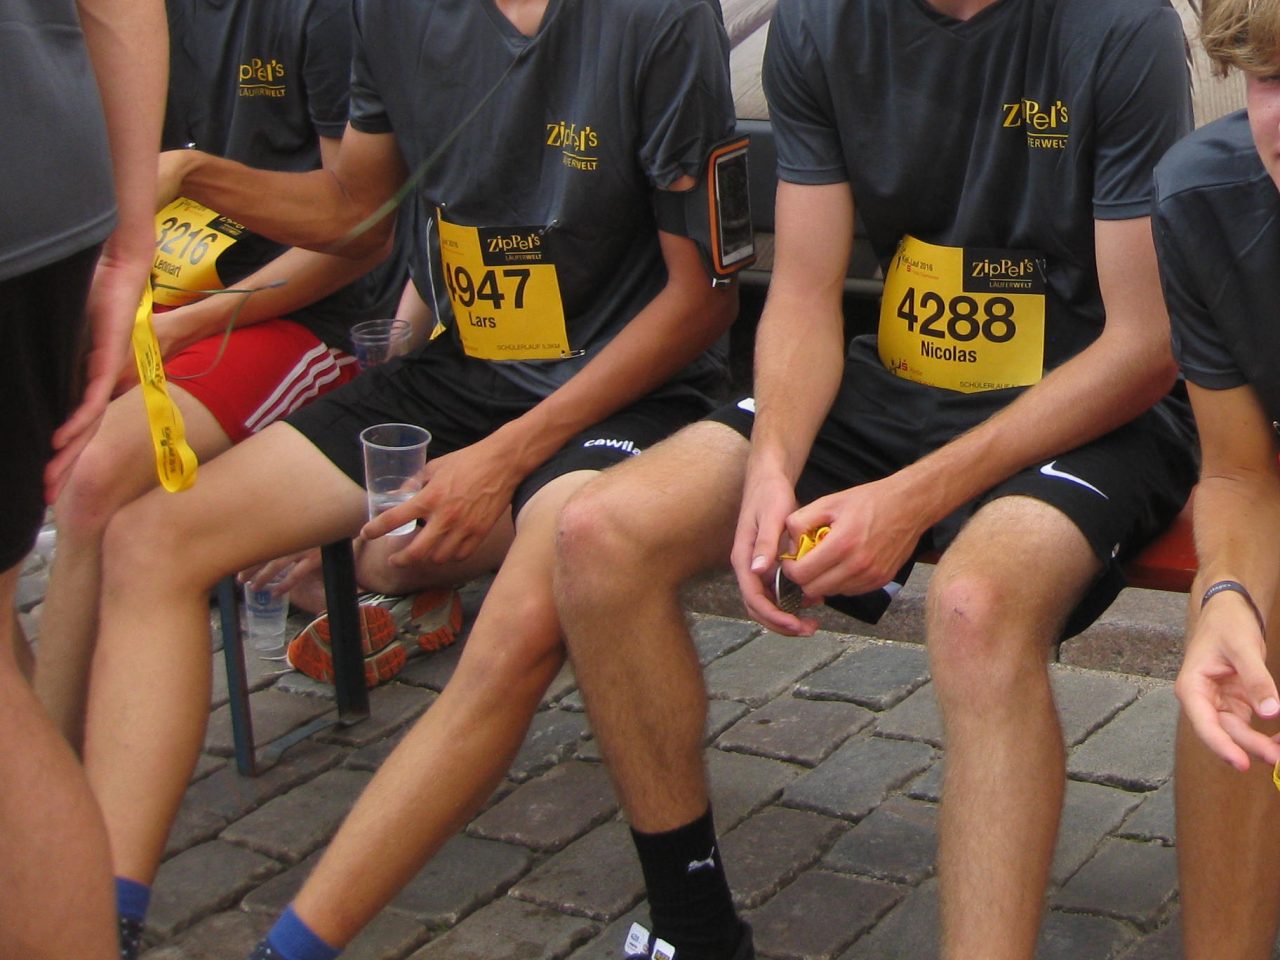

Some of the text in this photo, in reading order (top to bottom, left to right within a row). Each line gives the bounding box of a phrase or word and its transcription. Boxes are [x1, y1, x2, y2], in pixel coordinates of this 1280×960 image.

[155, 216, 219, 266] 3216
[468, 311, 497, 329] Lars
[896, 286, 1017, 344] 4288
[920, 339, 978, 363] Nicolas
